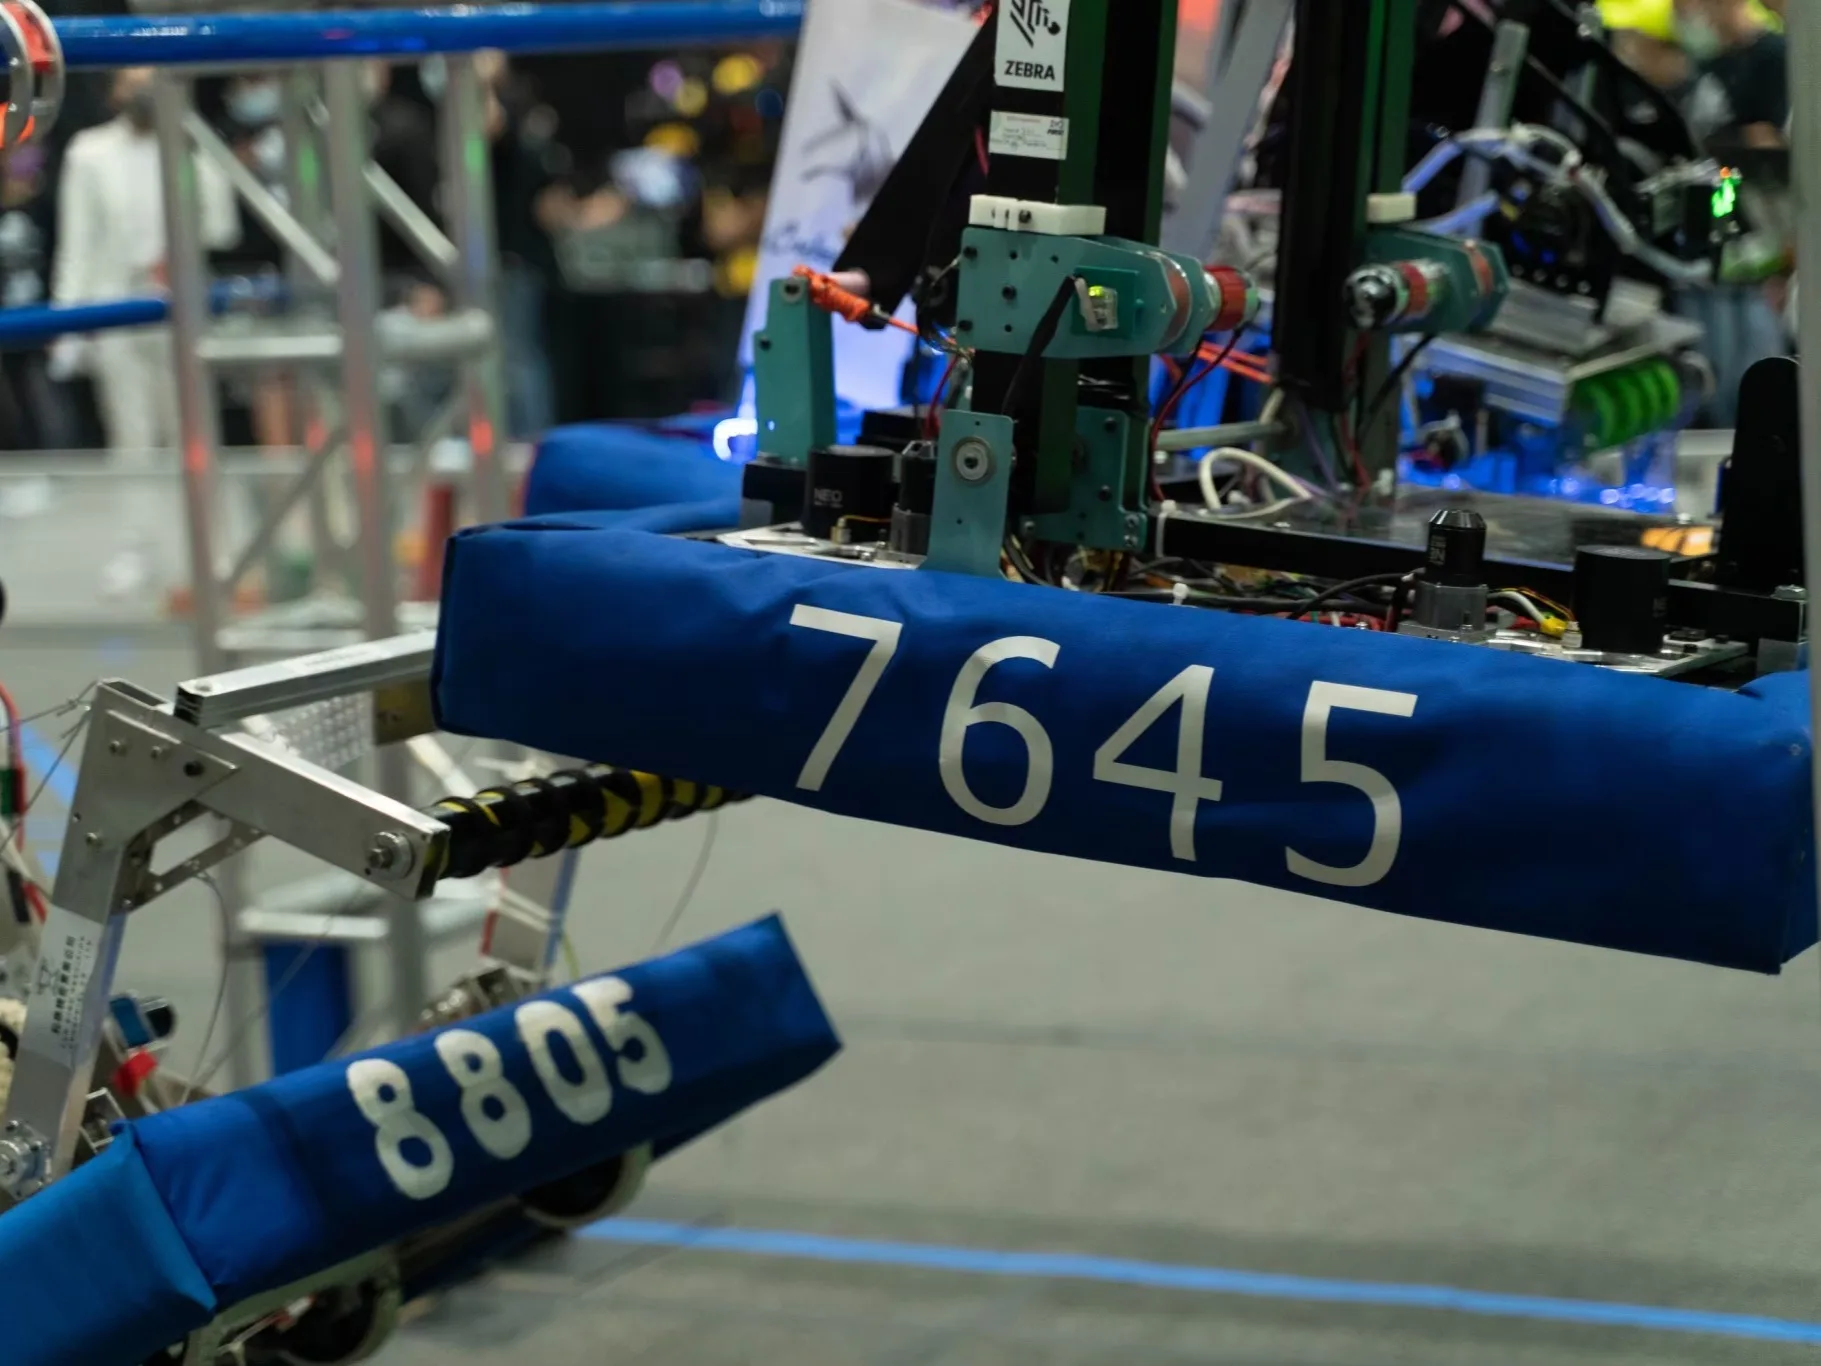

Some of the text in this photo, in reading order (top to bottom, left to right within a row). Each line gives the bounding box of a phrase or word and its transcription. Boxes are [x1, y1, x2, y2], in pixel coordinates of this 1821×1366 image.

[1005, 60, 1056, 80] ZEBRA
[814, 489, 842, 503] NEO
[790, 604, 1418, 888] 7645
[347, 976, 673, 1199] 8805
